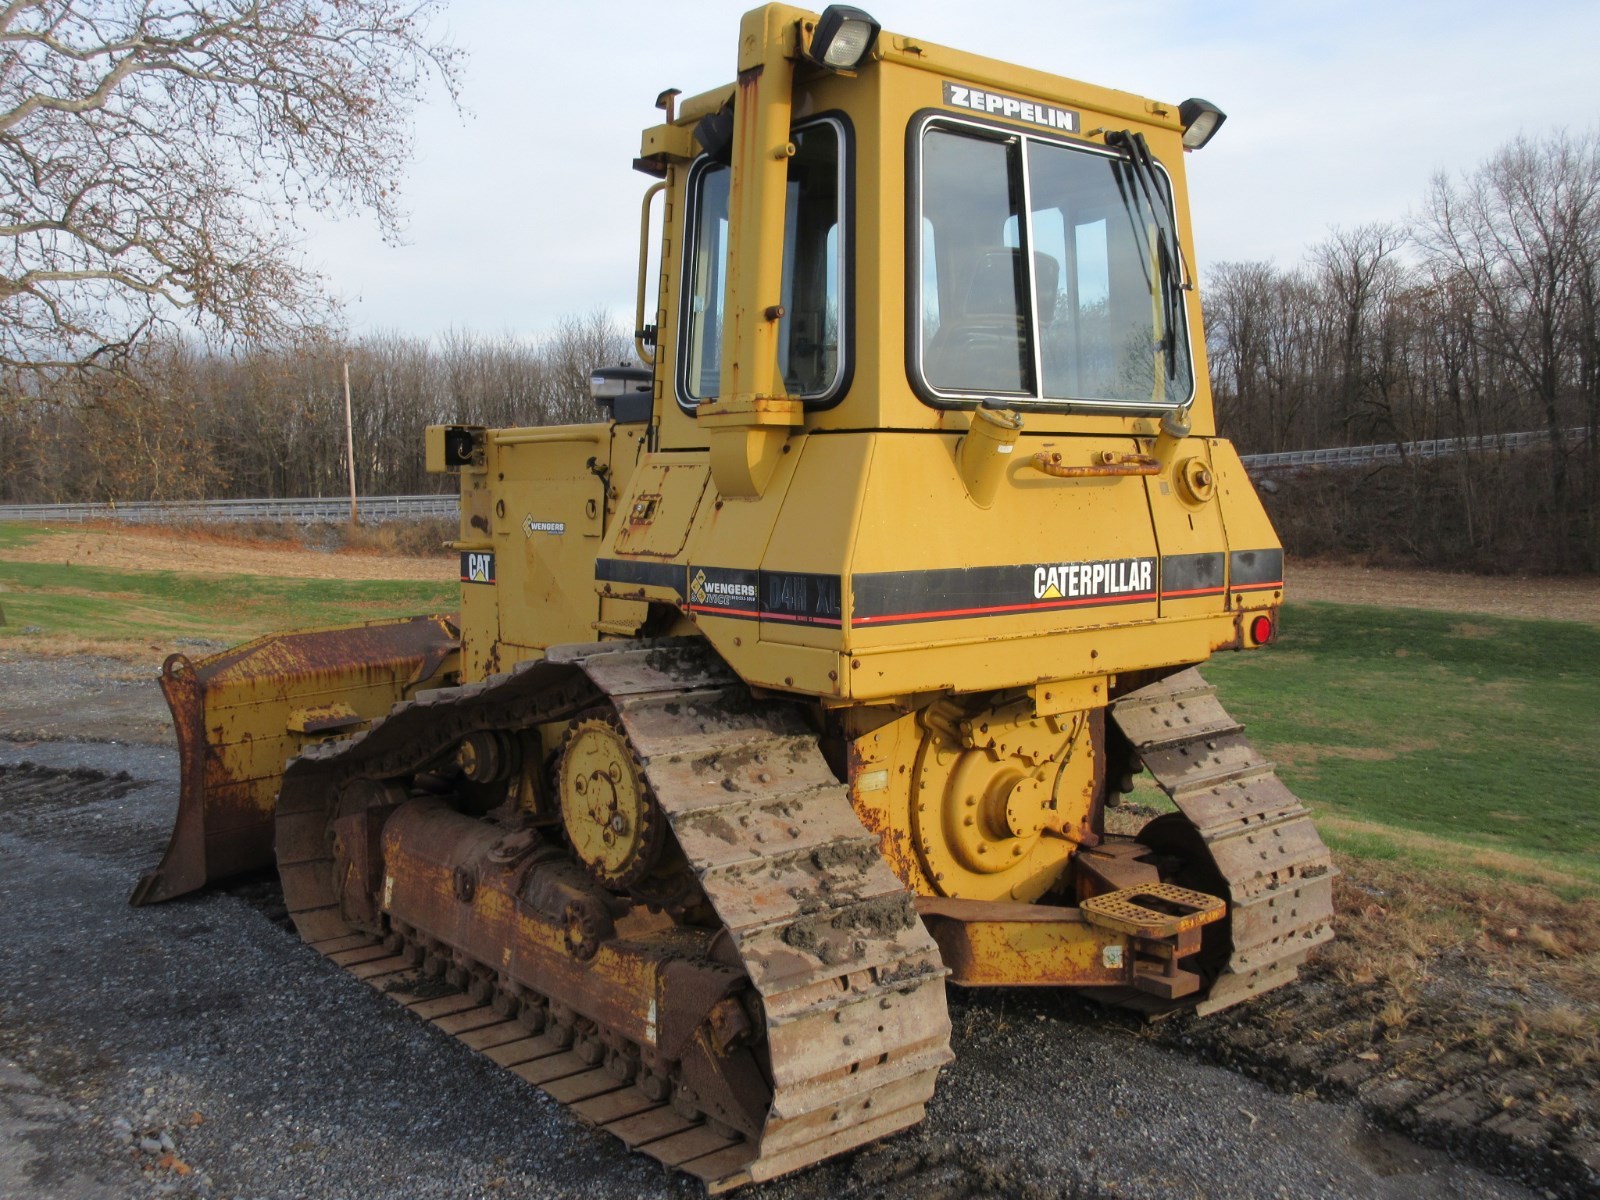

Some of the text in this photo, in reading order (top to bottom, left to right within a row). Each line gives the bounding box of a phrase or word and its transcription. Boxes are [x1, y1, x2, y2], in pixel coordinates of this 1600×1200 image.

[950, 85, 1073, 130] ZEPPELIN
[531, 522, 564, 531] WENGERS
[469, 553, 491, 582] CAT
[1034, 561, 1151, 599] CATERPILLAR
[704, 582, 755, 596] WENGERS
